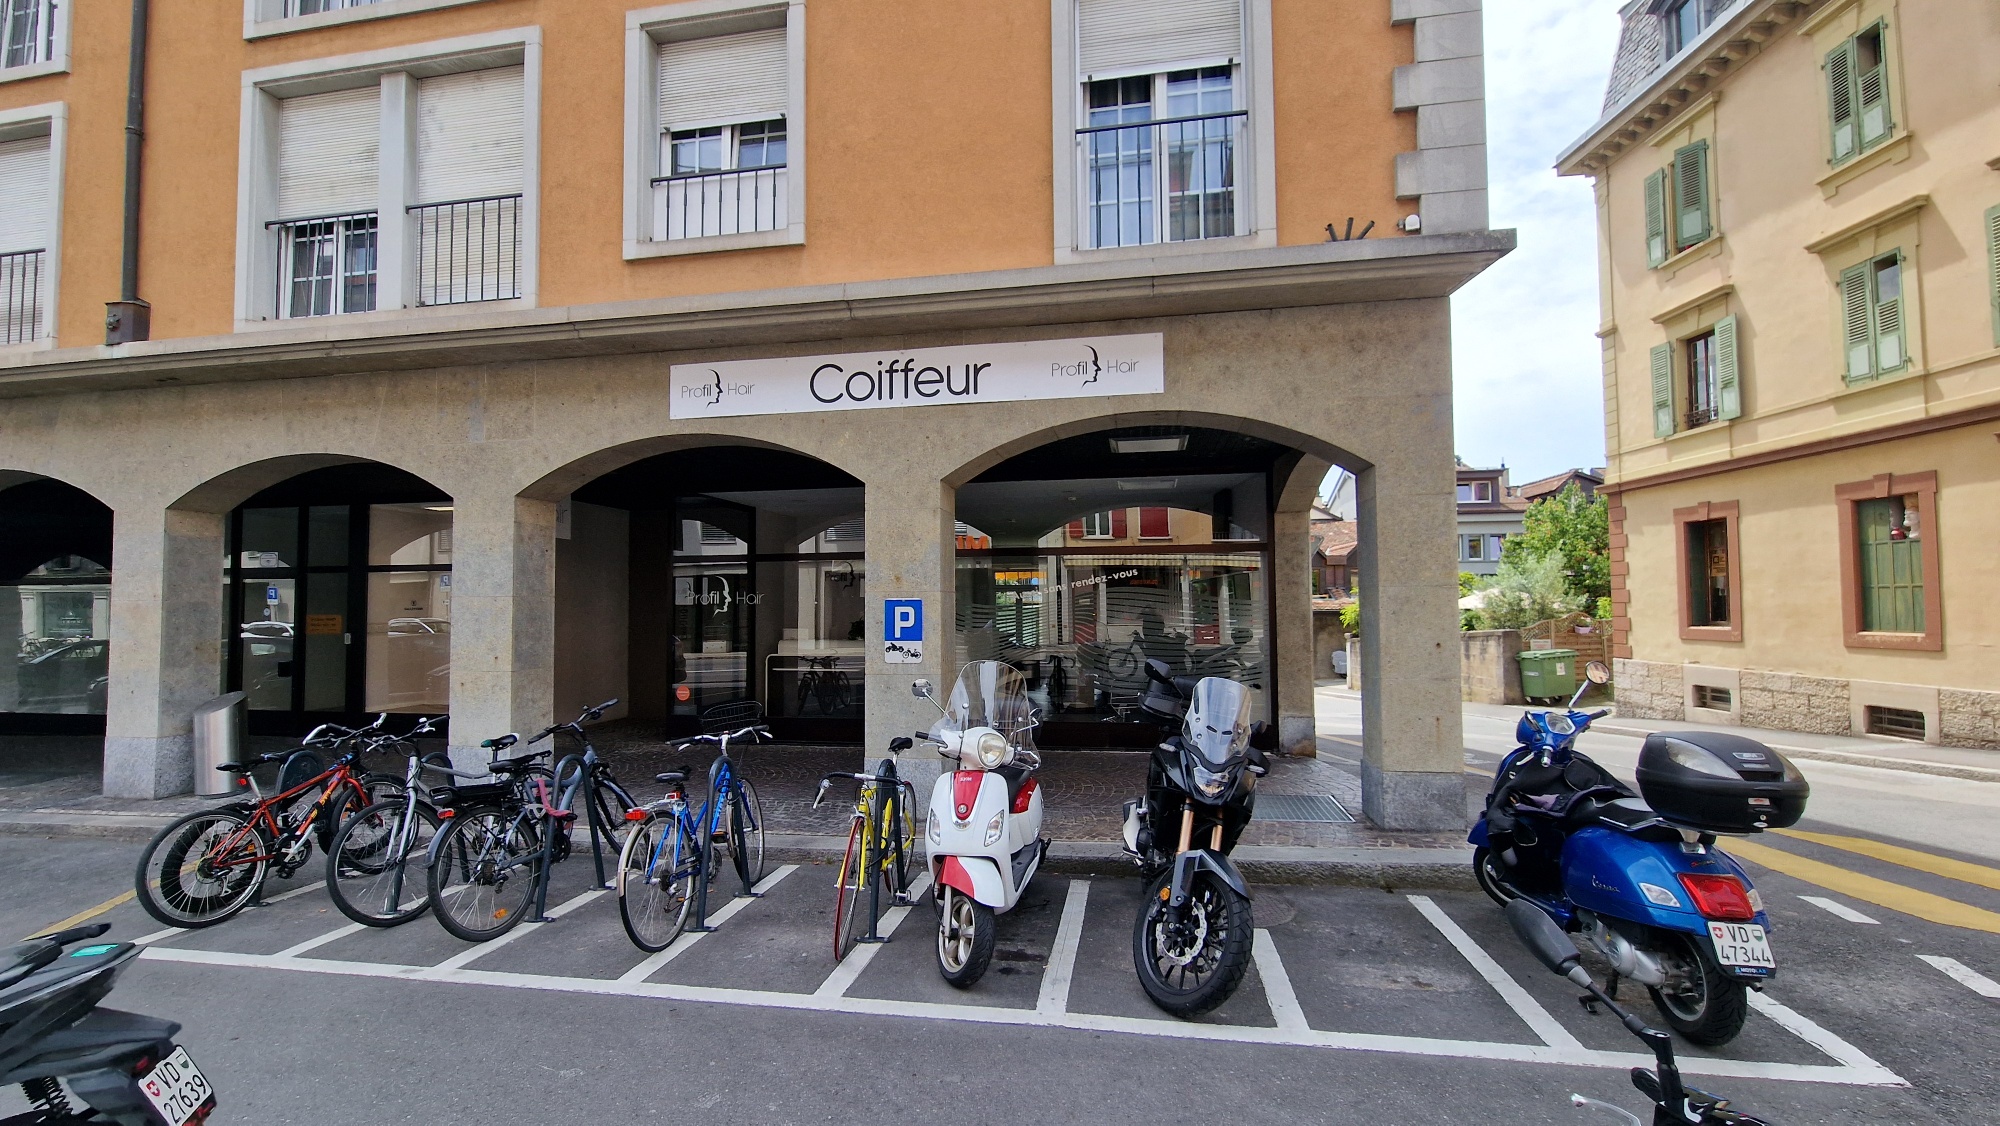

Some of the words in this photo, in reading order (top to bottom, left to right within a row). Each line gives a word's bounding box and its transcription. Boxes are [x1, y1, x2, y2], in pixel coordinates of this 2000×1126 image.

[1051, 361, 1088, 377] Profil
[1107, 359, 1140, 374] Hair
[681, 384, 712, 399] Profil
[727, 382, 755, 396] Hair
[809, 358, 991, 404] Coiffeur
[1043, 584, 1067, 594] sans
[1071, 569, 1138, 589] rendez-vous
[688, 590, 720, 605] Profil
[736, 591, 765, 605] Hair
[894, 606, 915, 638] P
[1726, 925, 1750, 943] VD
[1721, 945, 1771, 964] 47344
[155, 1062, 181, 1089] VD
[163, 1074, 207, 1125] 27639
